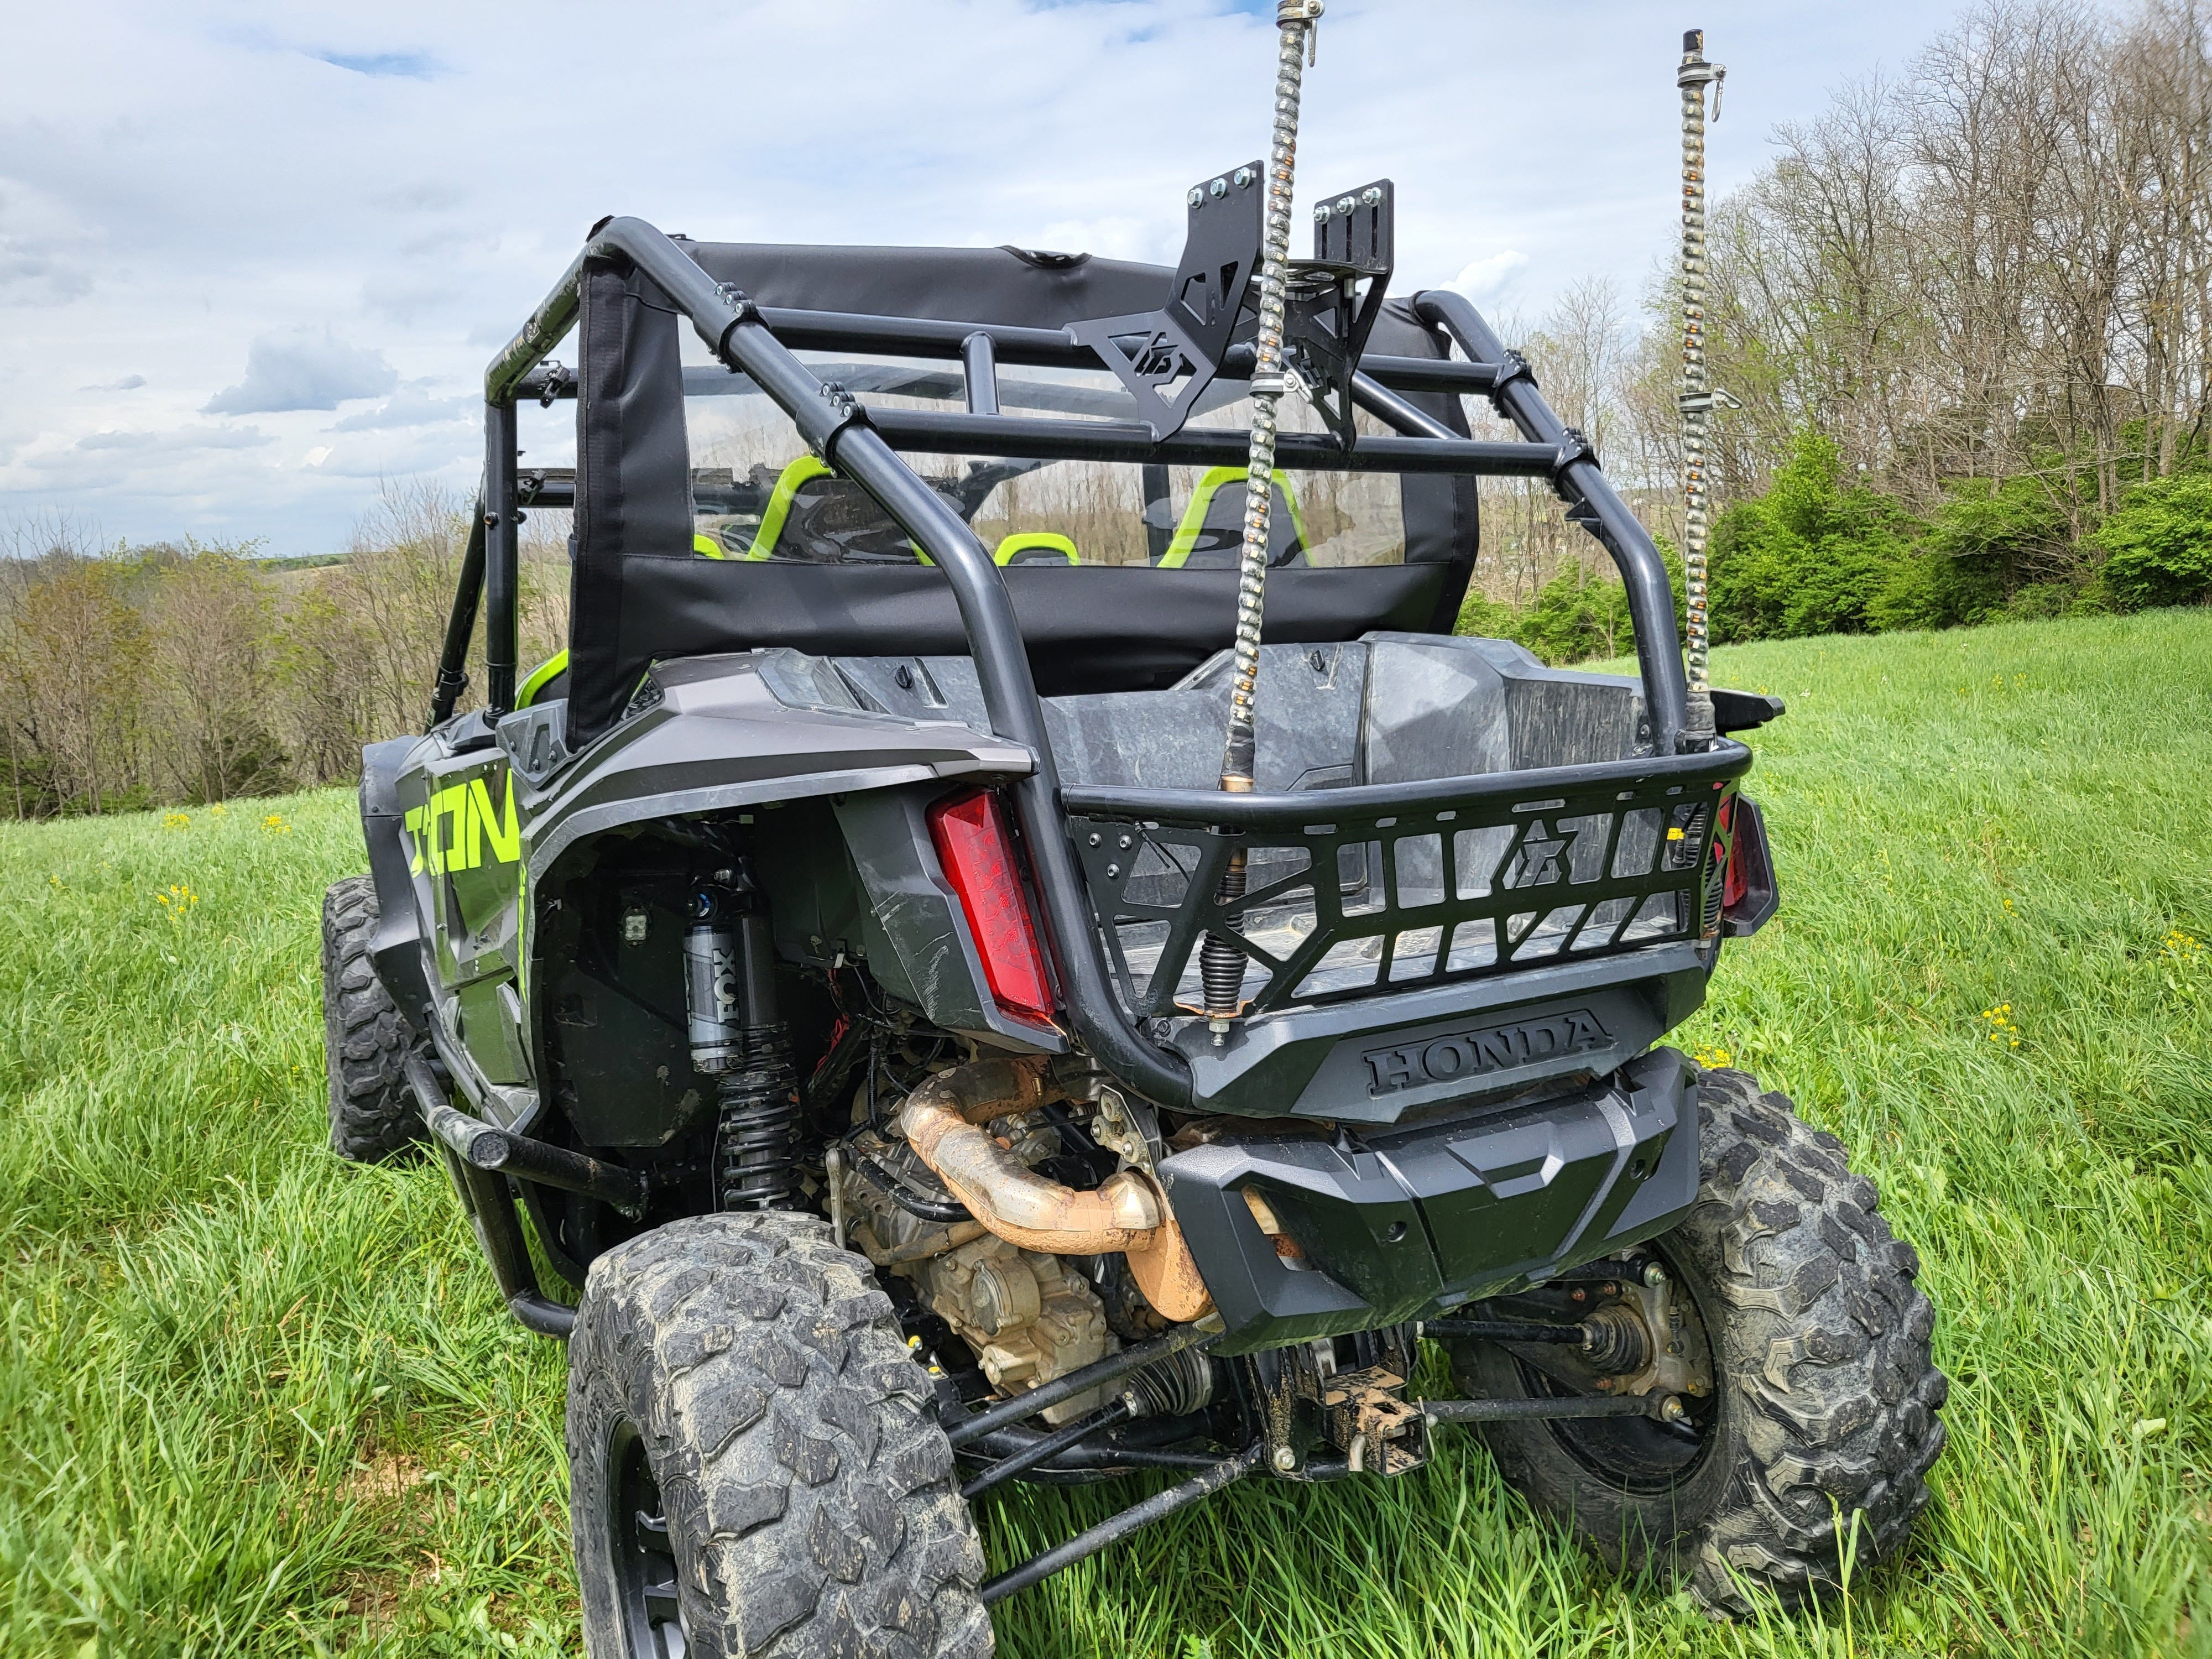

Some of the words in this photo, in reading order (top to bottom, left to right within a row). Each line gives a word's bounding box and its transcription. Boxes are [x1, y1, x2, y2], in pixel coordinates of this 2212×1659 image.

[405, 768, 520, 878] TON
[713, 949, 739, 1023] FOX
[1365, 1013, 1615, 1096] HONDA
